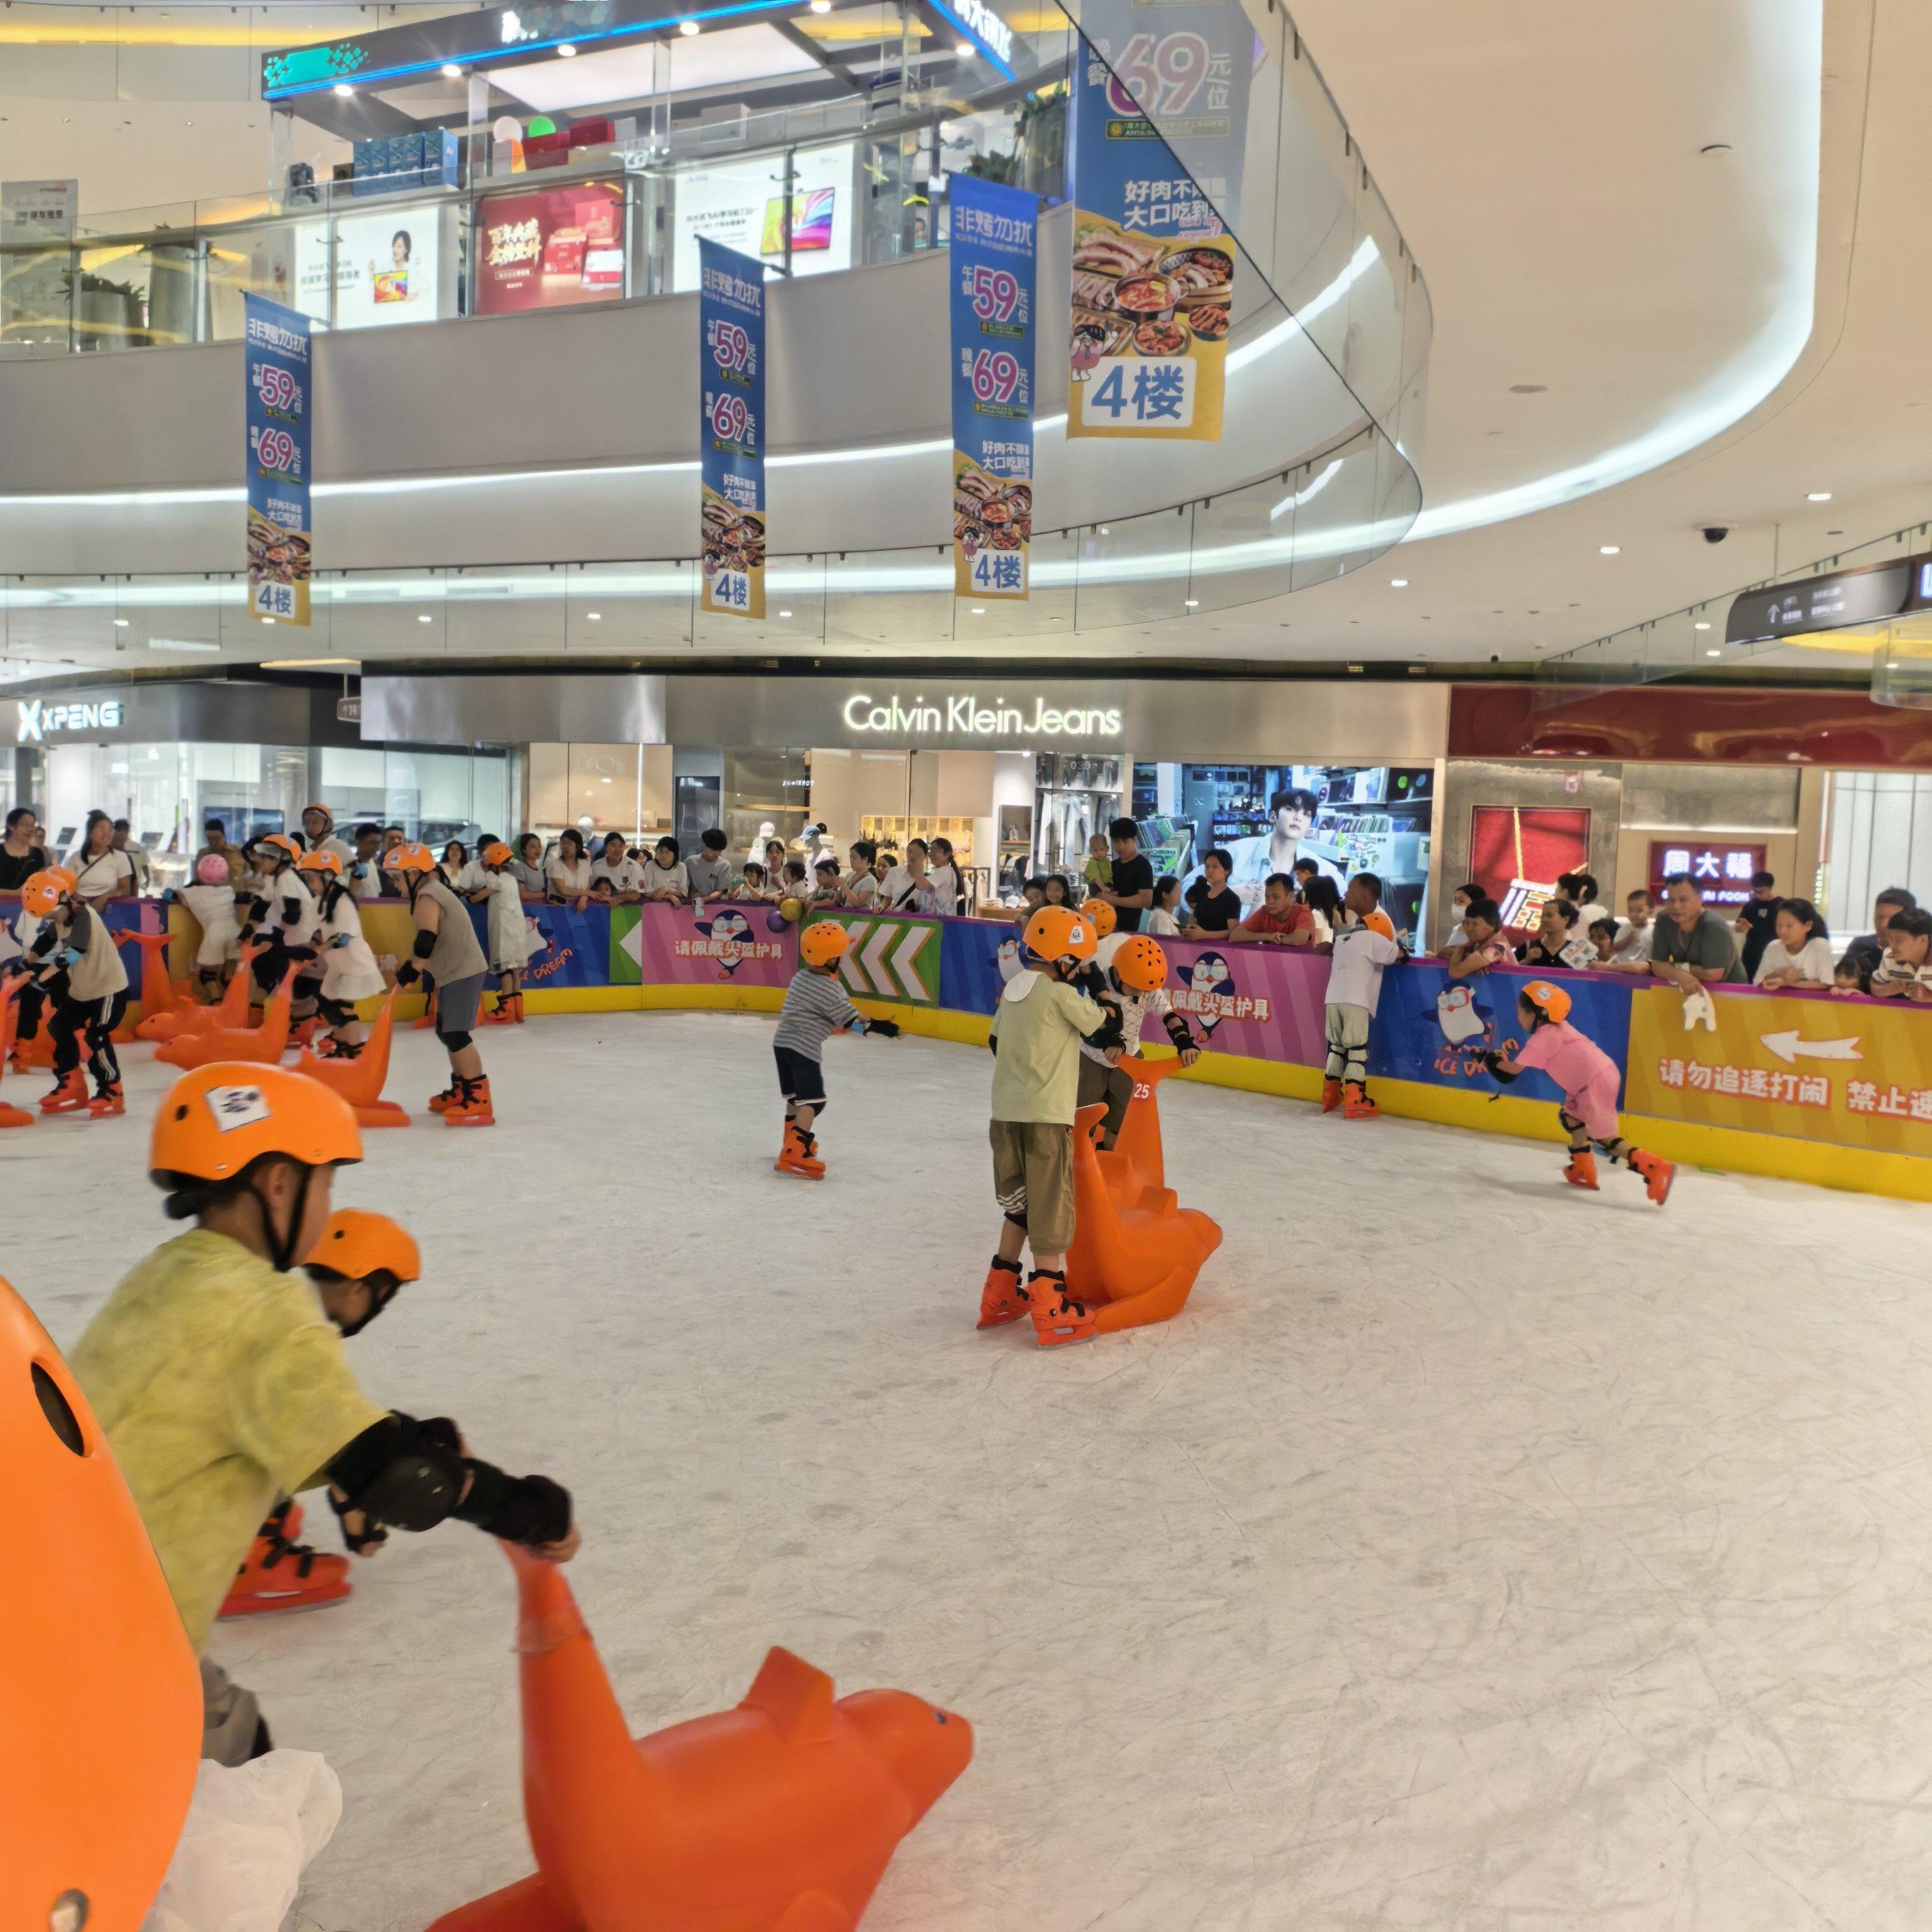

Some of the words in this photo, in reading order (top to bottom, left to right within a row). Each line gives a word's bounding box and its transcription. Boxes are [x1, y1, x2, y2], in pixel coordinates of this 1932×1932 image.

[1105, 32, 1210, 117] 69
[1123, 199, 1226, 231] 大口吃到
[972, 265, 1019, 323] 59
[713, 319, 748, 372] 59
[259, 364, 296, 410] 59
[971, 348, 1019, 403] 69
[1092, 364, 1185, 421] 4楼
[711, 392, 748, 442] 69
[257, 428, 294, 471] 69
[715, 574, 747, 606] 4楼
[975, 554, 1021, 589] 4楼
[258, 584, 292, 615] 4楼
[42, 701, 119, 732] XPENG
[844, 696, 941, 731] Calvin
[947, 696, 1022, 733] Klein
[1024, 697, 1121, 735] Jeans
[1662, 850, 1753, 879] 周大福
[1133, 1083, 1150, 1099] 25
[1659, 1058, 1828, 1106] 请勿追逐打闹
